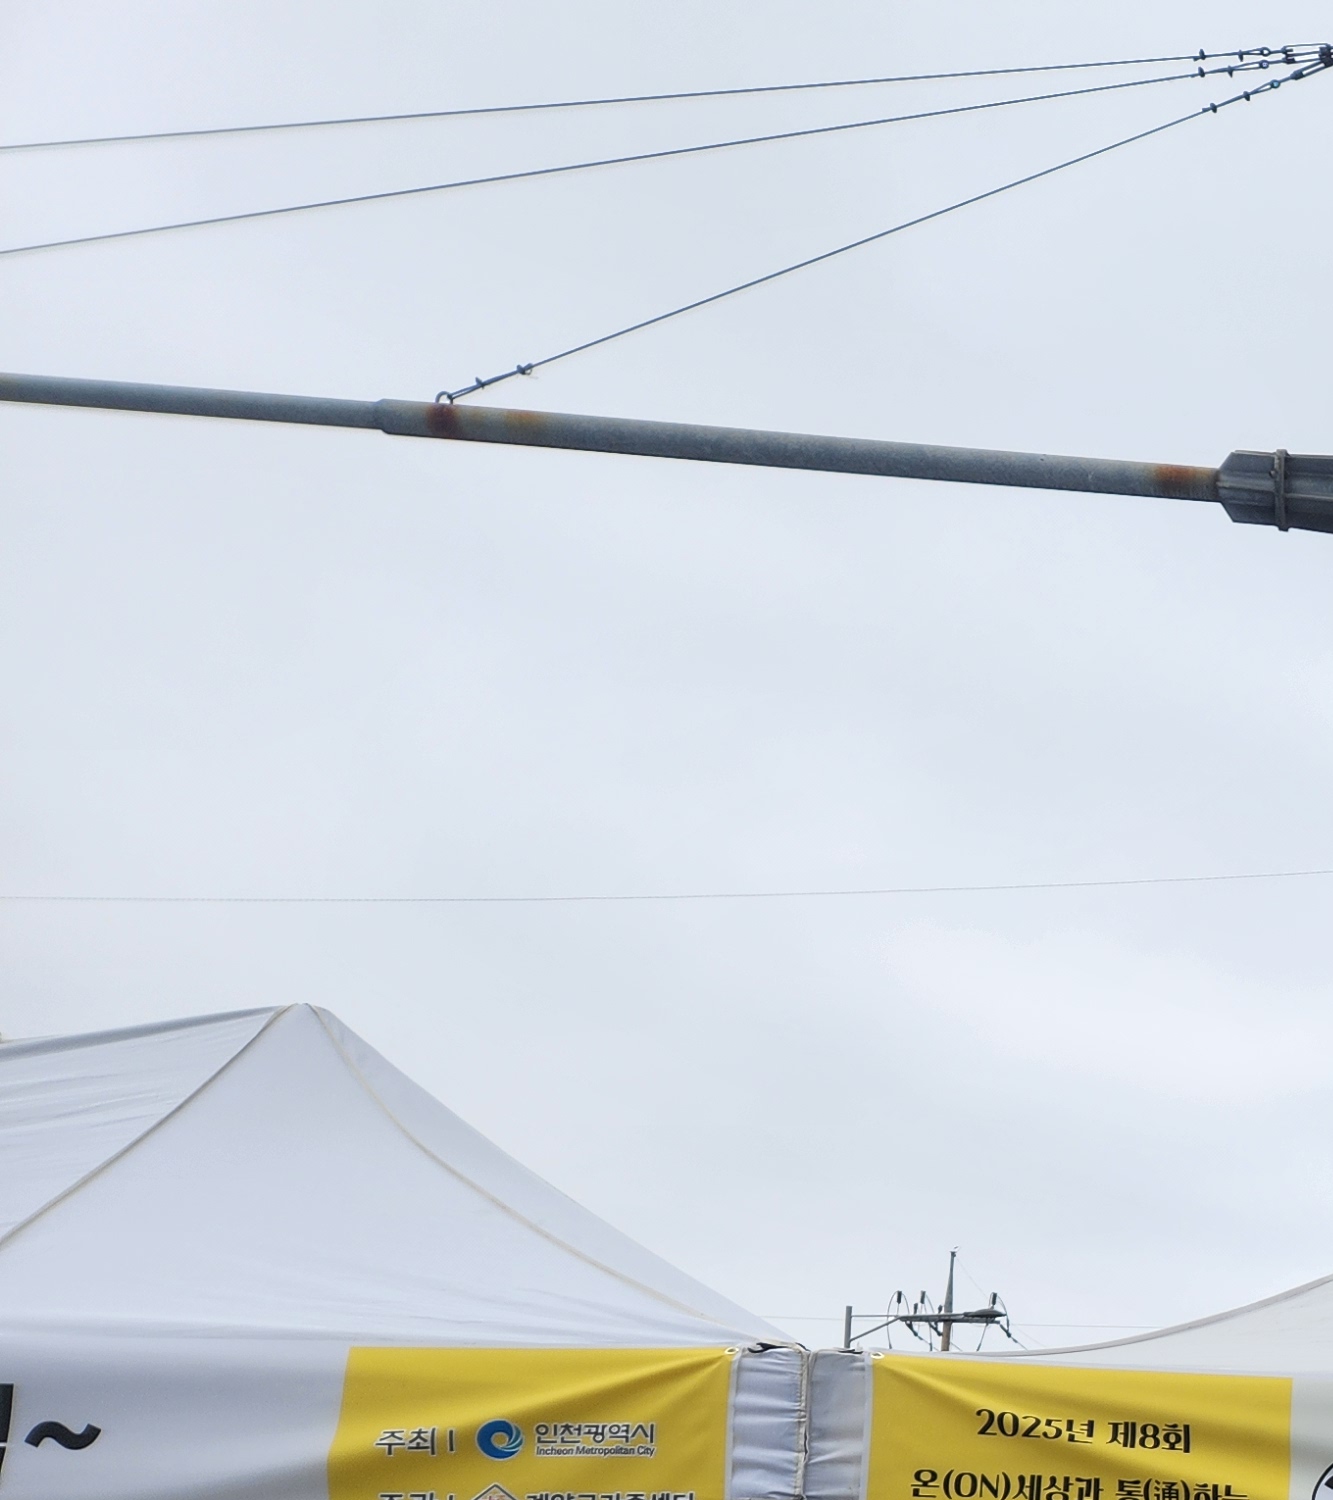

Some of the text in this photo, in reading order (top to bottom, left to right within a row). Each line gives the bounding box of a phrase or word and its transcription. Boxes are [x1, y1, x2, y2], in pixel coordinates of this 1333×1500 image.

[375, 1423, 655, 1456] 주최 인천광역시
[977, 1408, 1191, 1454] 2025년 제8회
[536, 1446, 655, 1458] Incheon Metropolitan City
